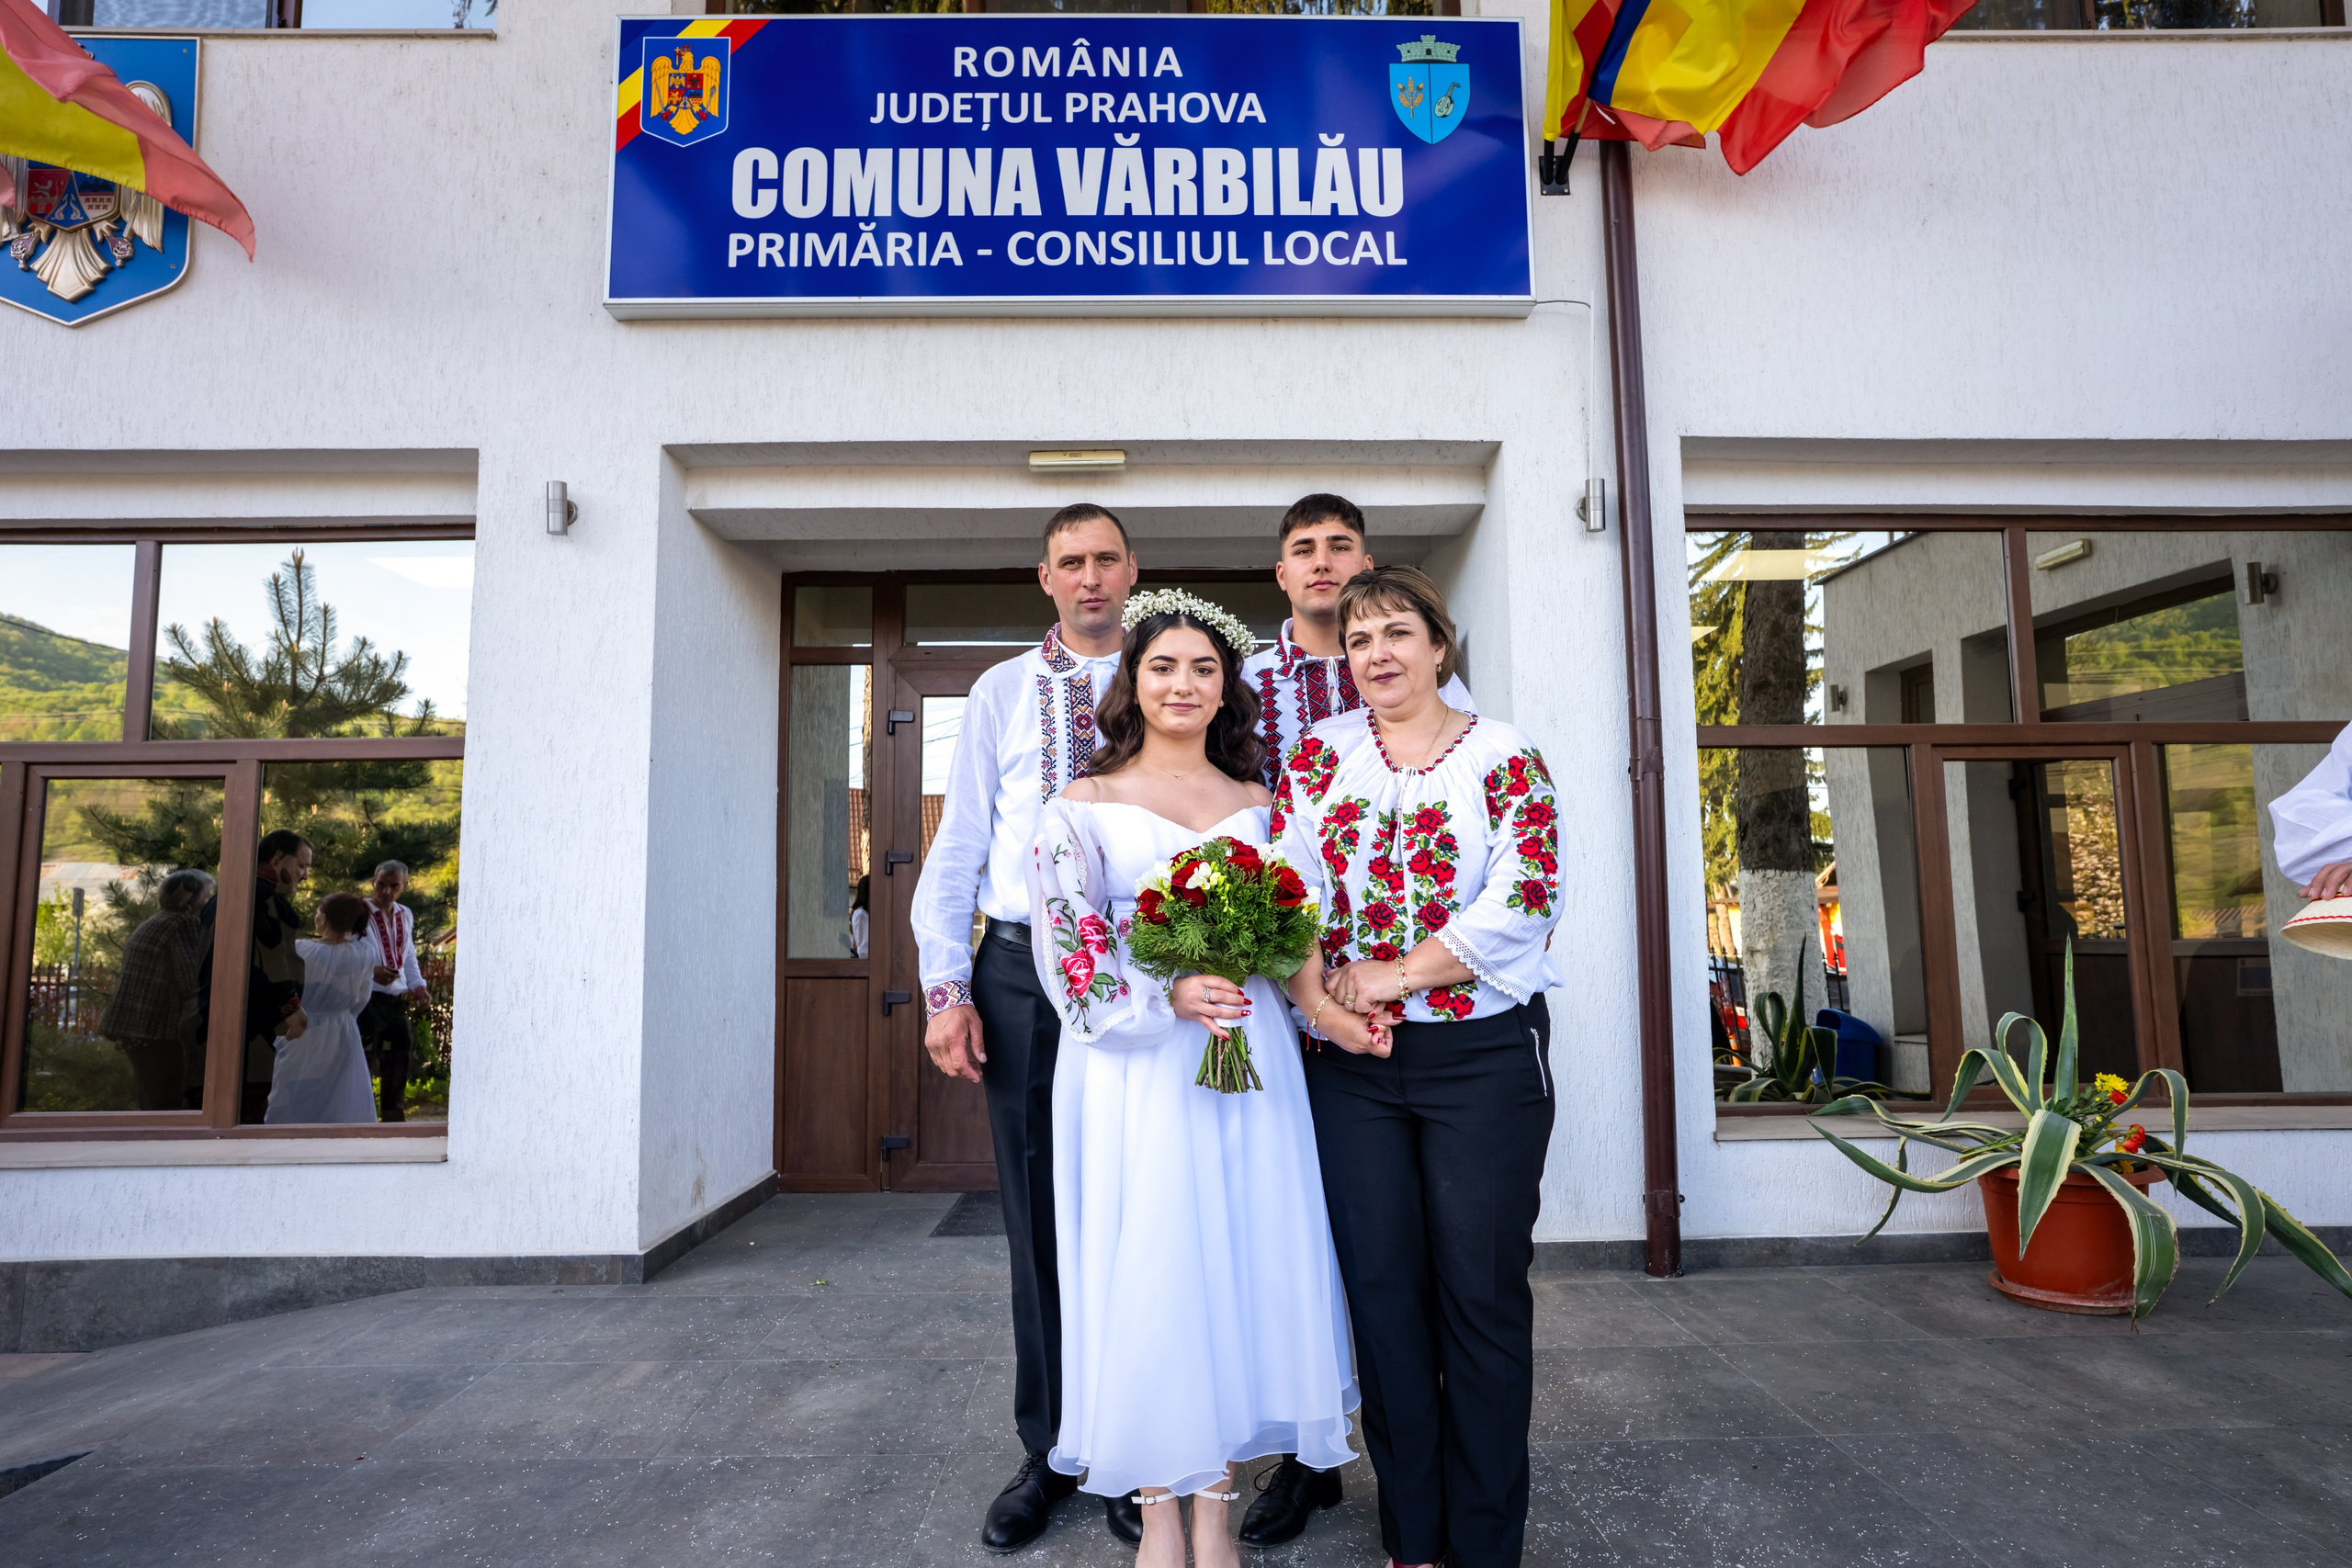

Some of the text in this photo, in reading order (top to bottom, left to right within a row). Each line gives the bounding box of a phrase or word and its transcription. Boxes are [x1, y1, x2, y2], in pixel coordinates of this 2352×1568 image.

[954, 38, 1183, 78] ROMÂNIA
[868, 92, 1267, 131] JUDEȚUL PRAHOVA
[731, 132, 1404, 219] COMUNA VĂRBILĂU
[728, 221, 964, 268] PRIMĂRIA
[1007, 231, 1250, 266] CONSILIUL
[1263, 230, 1408, 266] LOCAL
